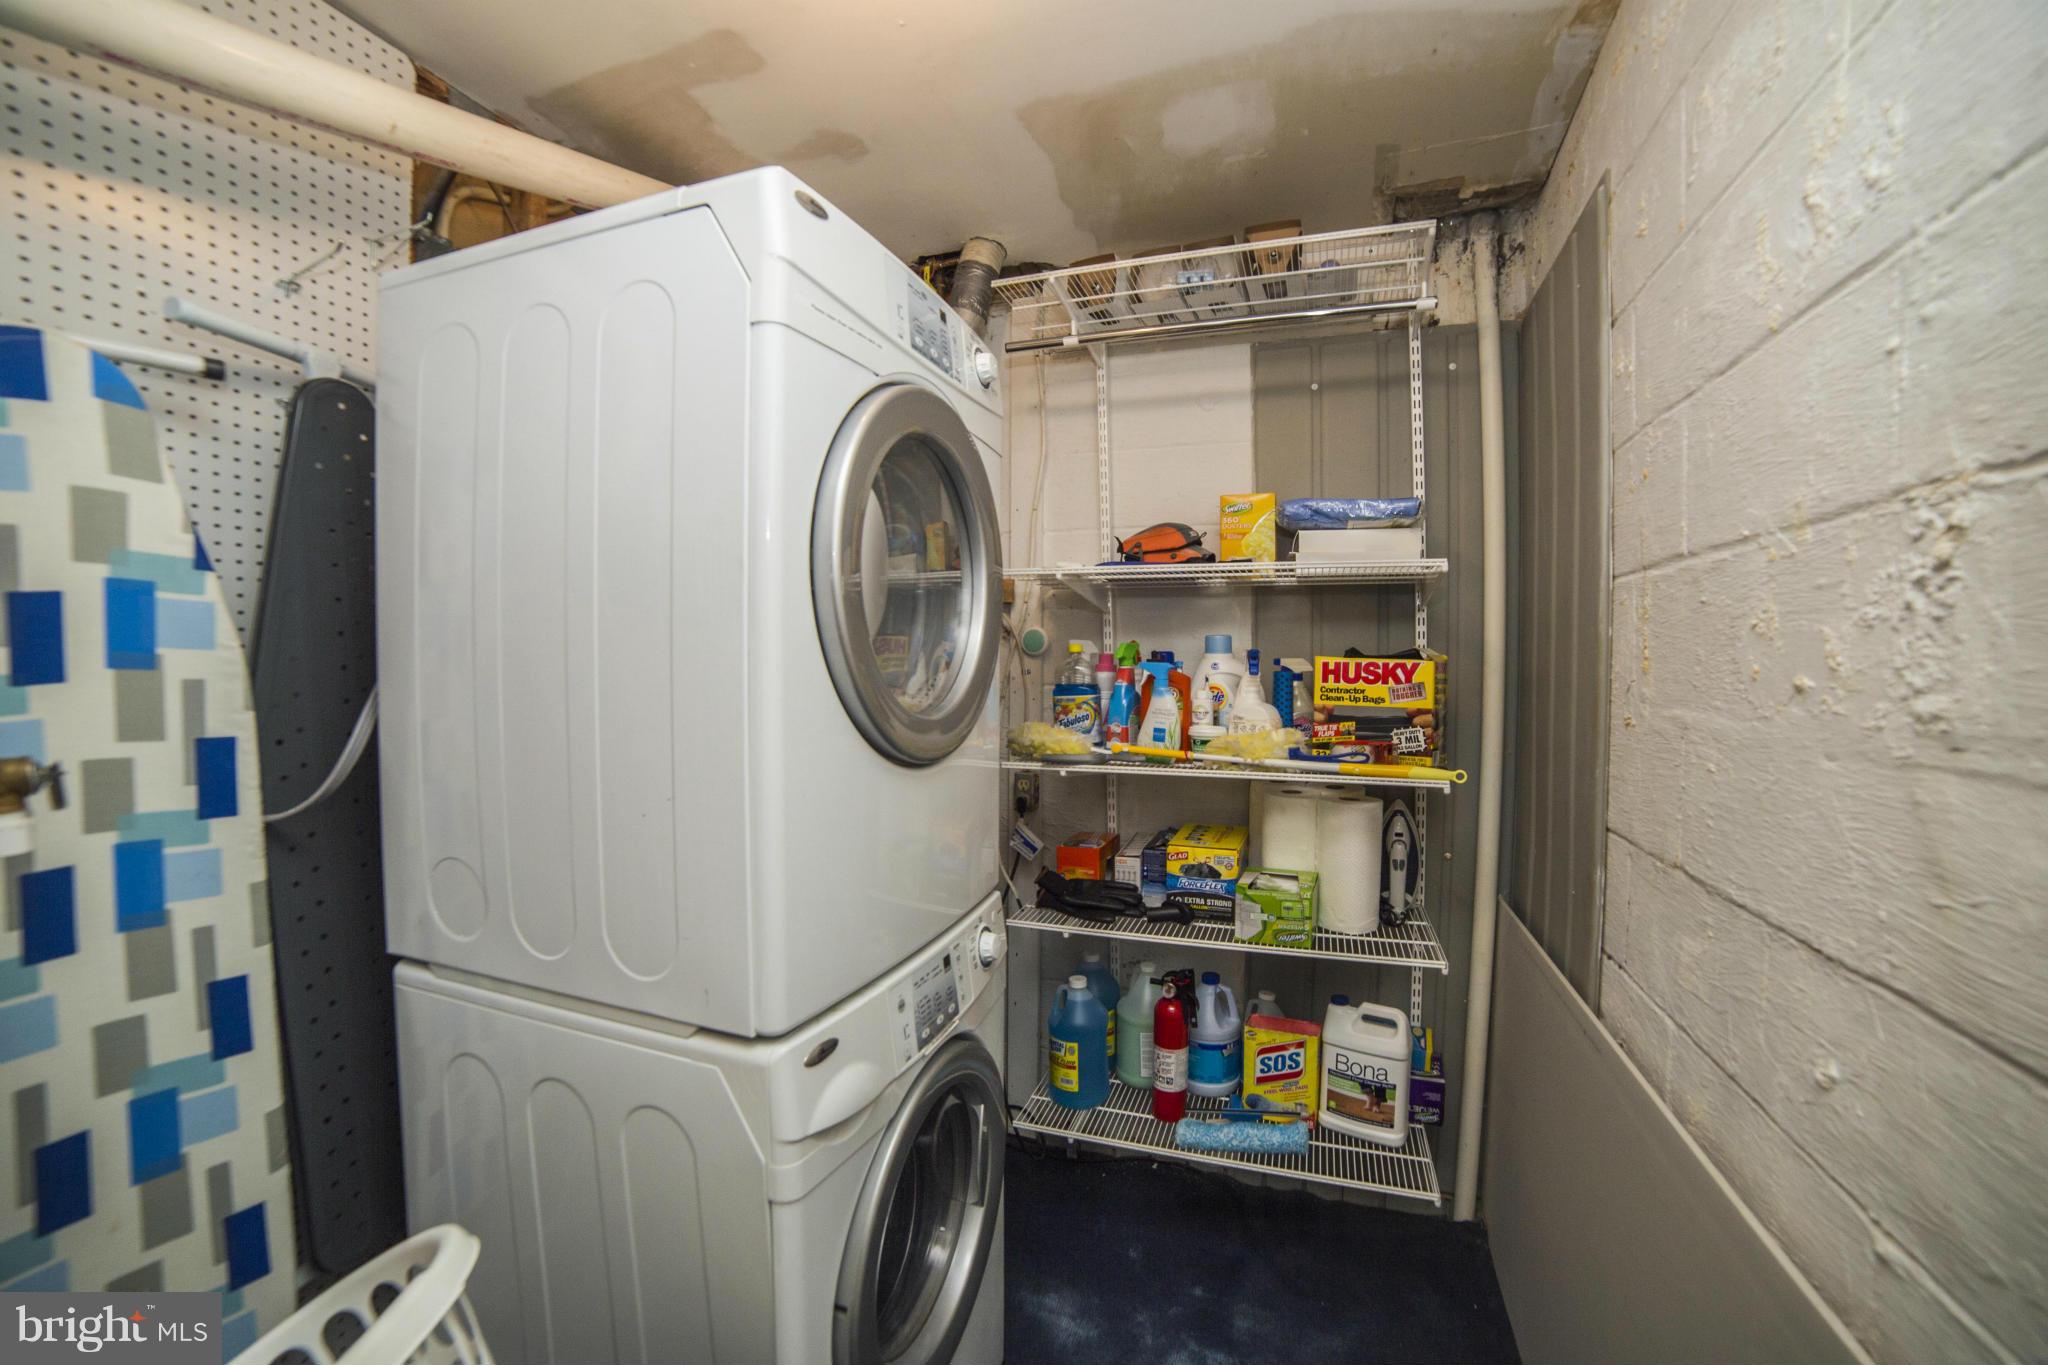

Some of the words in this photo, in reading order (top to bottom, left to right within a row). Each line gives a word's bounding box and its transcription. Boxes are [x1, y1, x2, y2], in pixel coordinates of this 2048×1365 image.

[1321, 661, 1421, 685] HUSKY
[1320, 686, 1366, 695] Contractor
[1362, 695, 1386, 704] Bags
[1058, 713, 1090, 729] Fabuloso
[1396, 736, 1403, 746] 3
[1404, 735, 1422, 745] MIL
[1168, 852, 1188, 860] GLAD
[1184, 896, 1205, 905] EXTRA
[1206, 899, 1233, 908] STRONG
[1335, 1053, 1388, 1082] Bona
